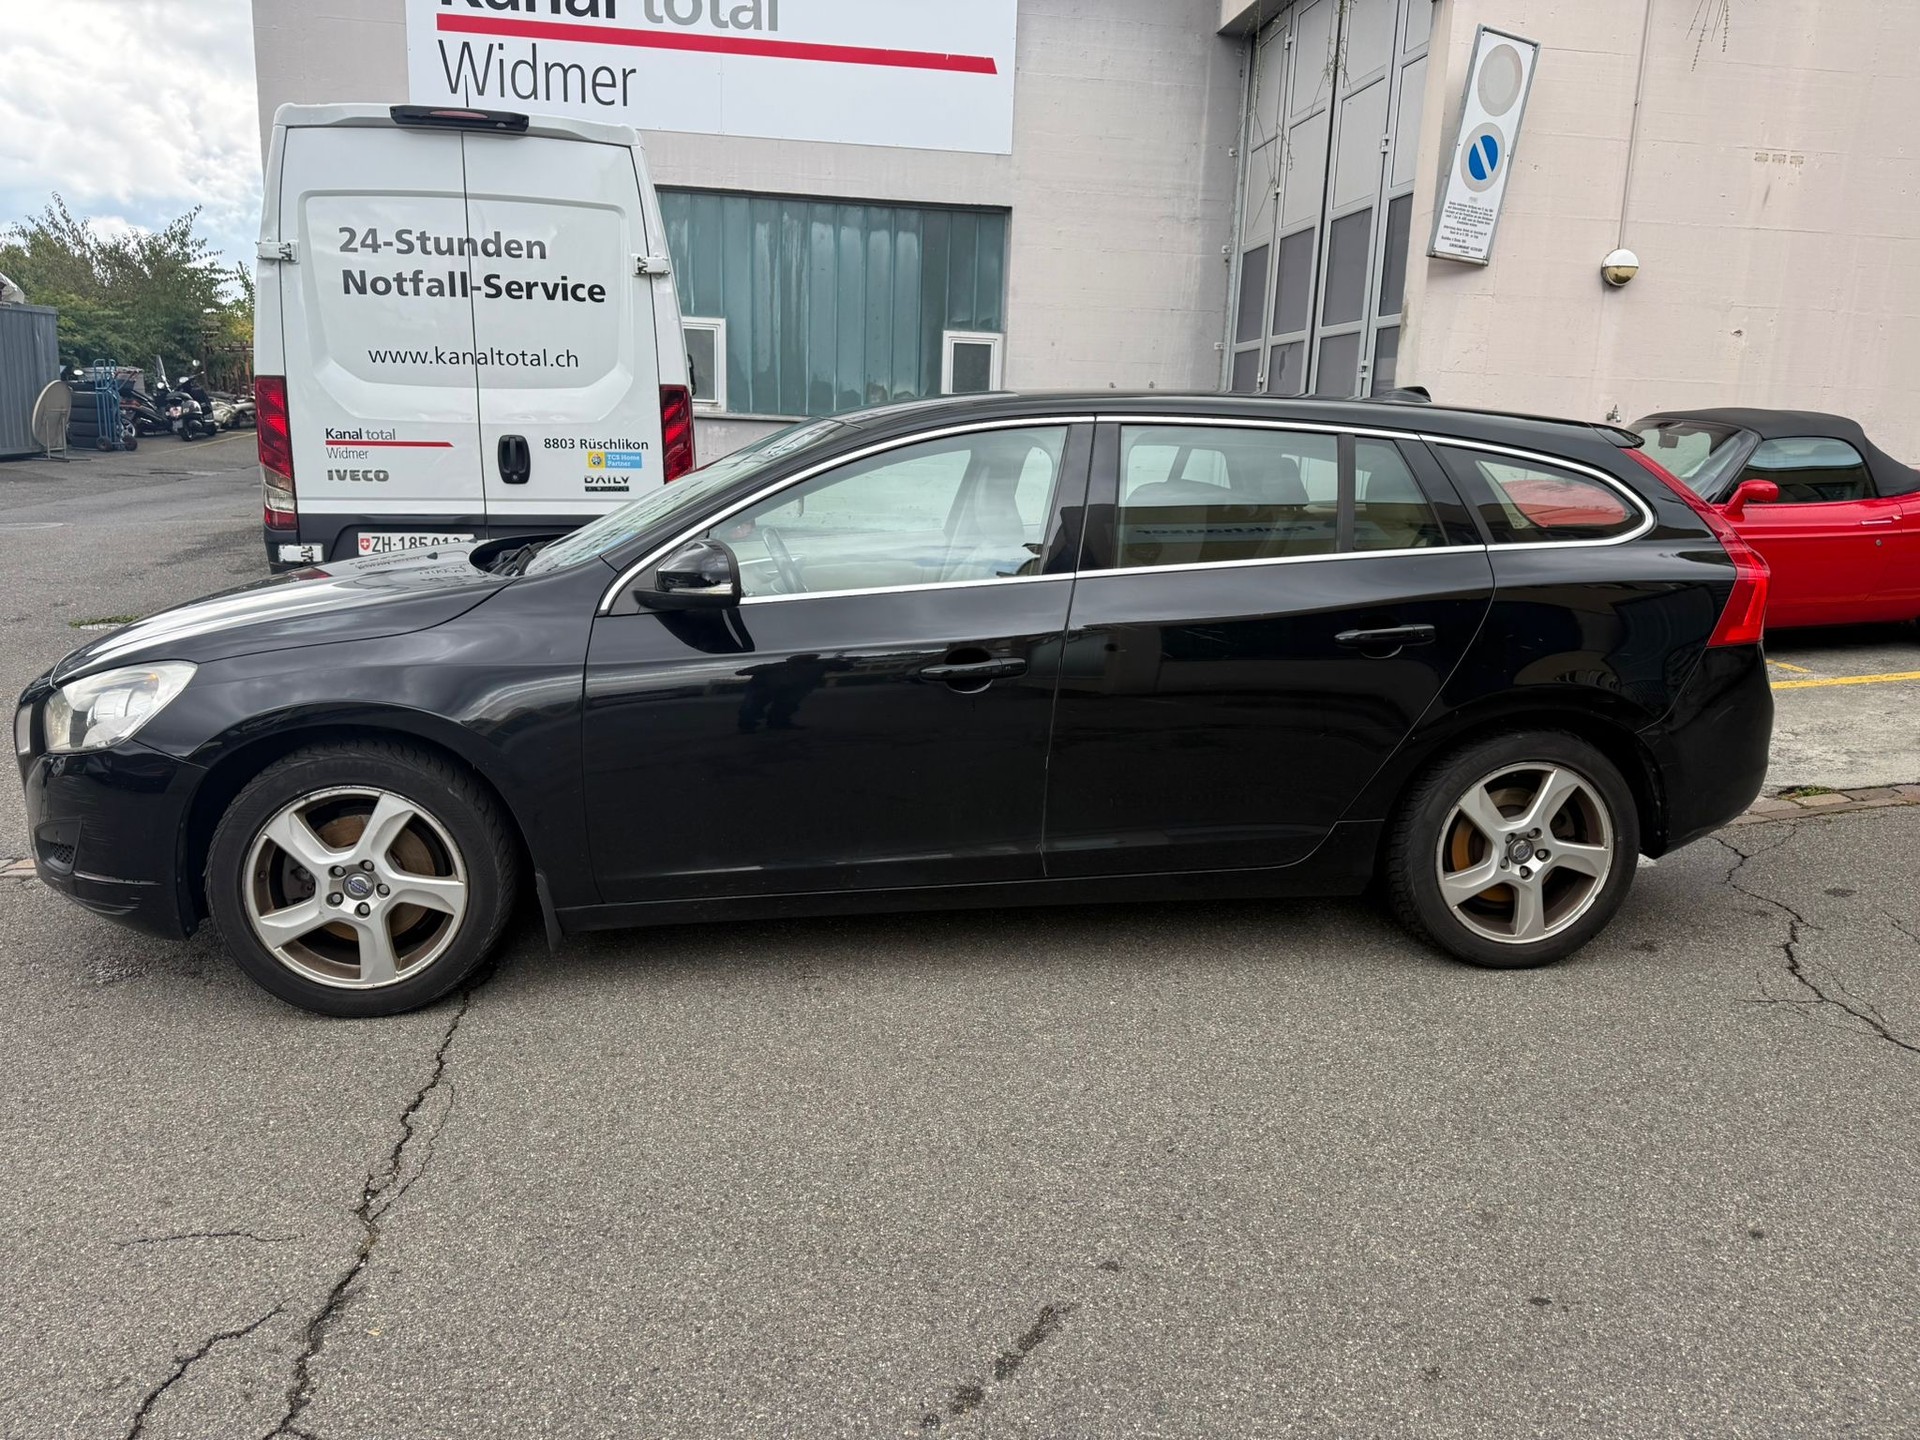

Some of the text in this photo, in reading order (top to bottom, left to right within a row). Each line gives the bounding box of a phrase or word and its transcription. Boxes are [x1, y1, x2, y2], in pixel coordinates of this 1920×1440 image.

[437, 39, 637, 107] Widmer
[338, 227, 547, 260] 24-Stunden
[342, 269, 607, 303] Notfall-Service
[368, 346, 579, 368] www.kanaltotal.ch
[325, 428, 396, 441] Kanal total
[544, 438, 649, 450] 8803 Rüschlikon
[326, 447, 369, 460] Widmer
[327, 469, 390, 482] IVECO
[584, 475, 630, 485] DAILY
